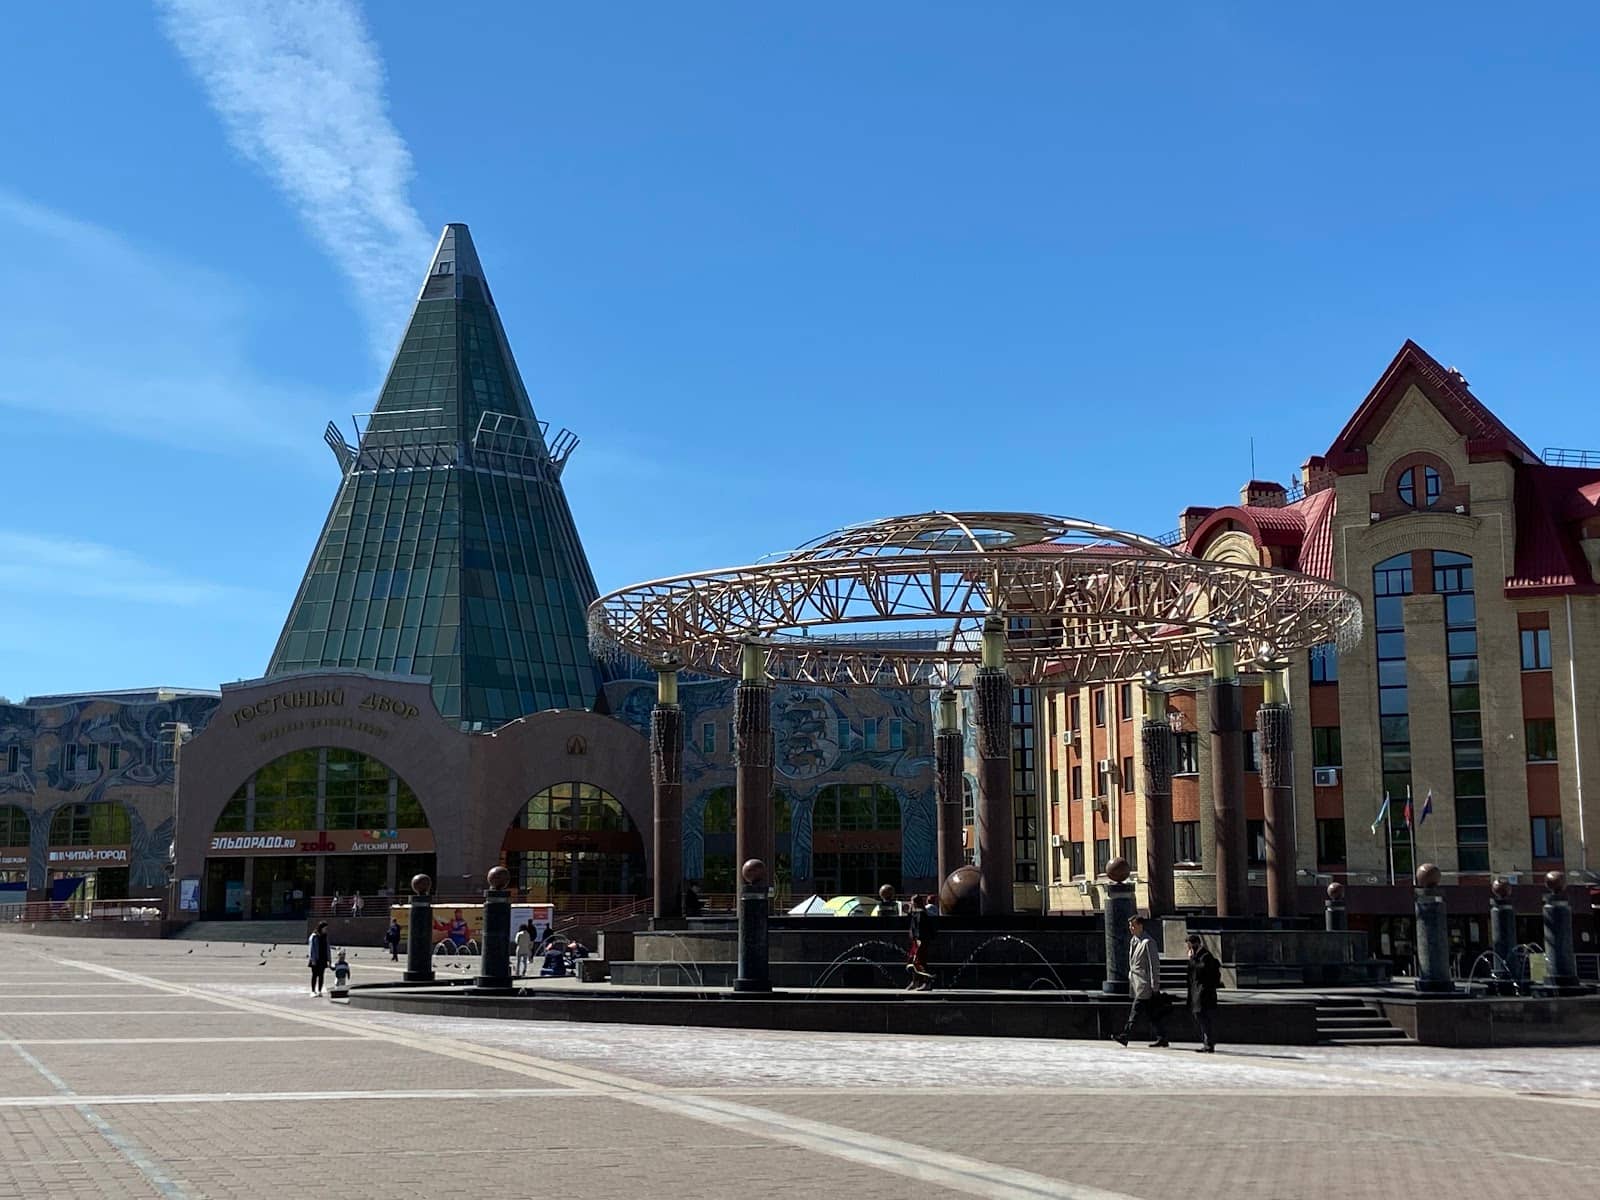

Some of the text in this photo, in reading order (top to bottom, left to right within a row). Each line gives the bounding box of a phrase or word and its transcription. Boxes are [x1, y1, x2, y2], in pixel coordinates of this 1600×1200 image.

[358, 692, 420, 720] ДВОР
[351, 841, 409, 853] Детский мир
[65, 849, 127, 861] ЧИТАЙ-ГОРОД
